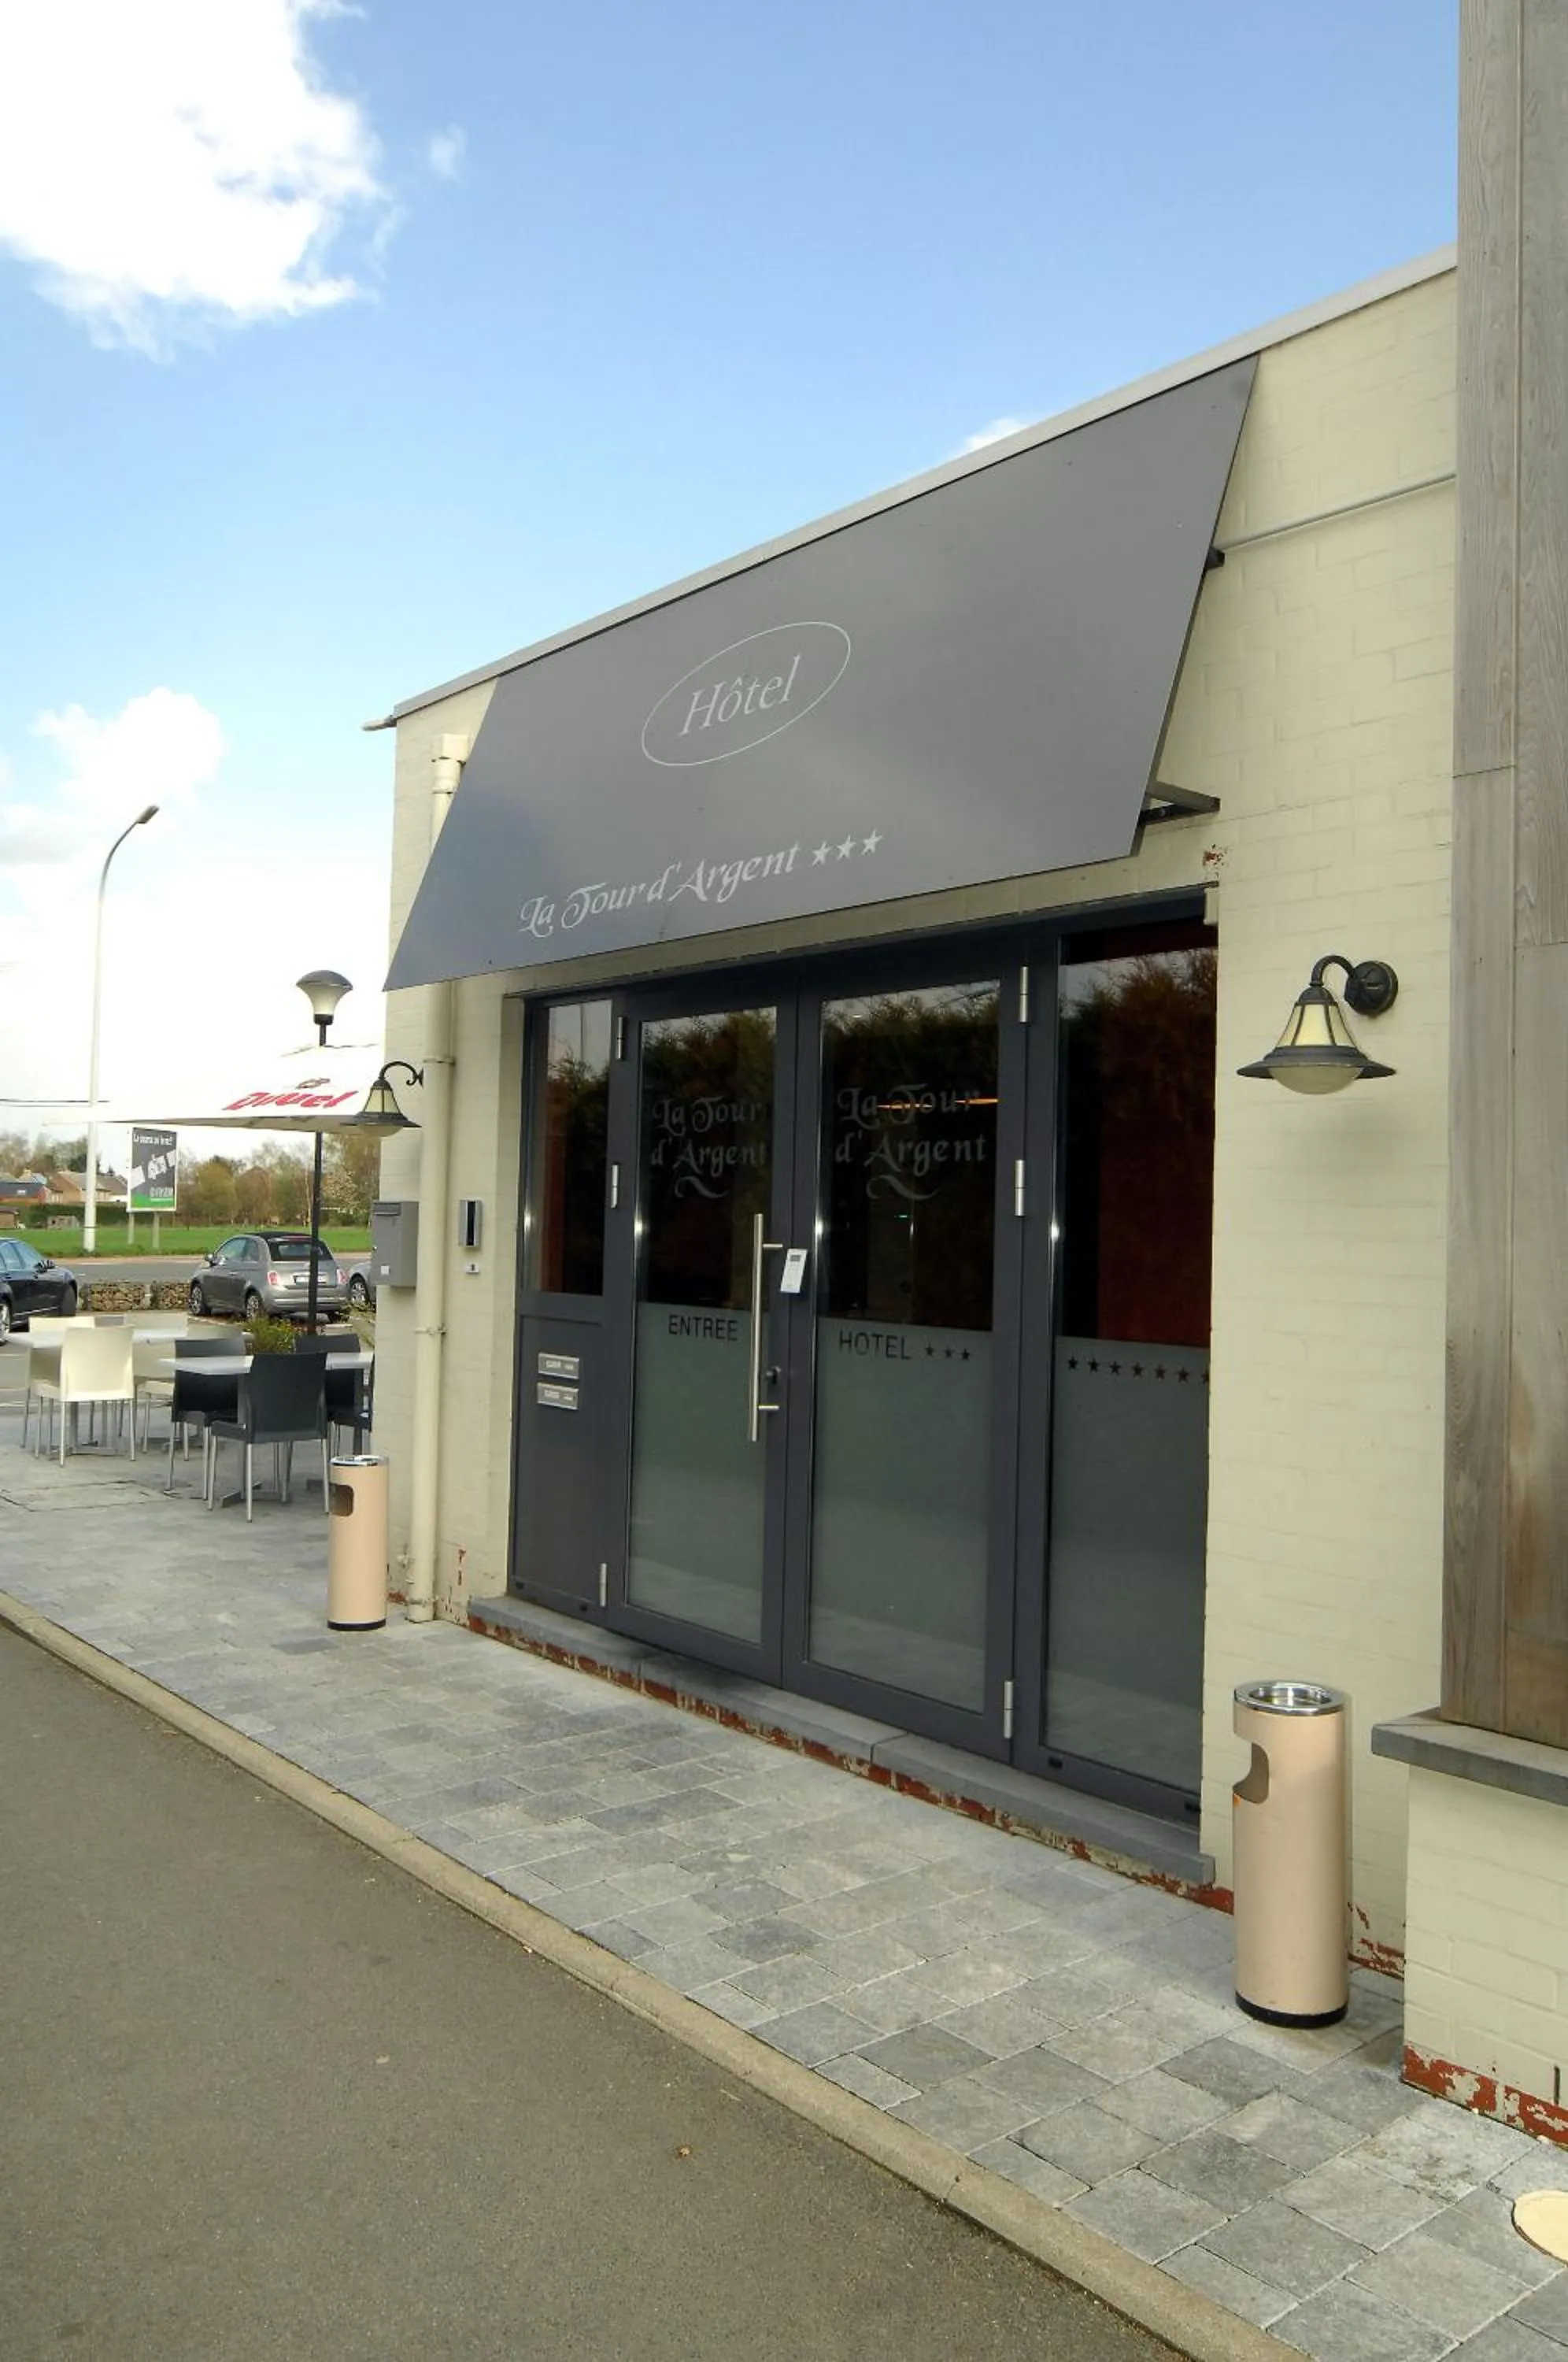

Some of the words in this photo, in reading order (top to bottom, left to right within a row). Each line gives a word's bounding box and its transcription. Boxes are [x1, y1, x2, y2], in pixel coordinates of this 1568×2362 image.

[679, 653, 801, 737] Hôtel
[519, 894, 554, 939] La
[560, 882, 647, 930] Tour
[646, 841, 801, 903] d'Argent
[653, 1098, 686, 1137] La
[691, 1095, 762, 1134] Tour
[837, 1087, 881, 1130] La
[668, 1314, 738, 1341] ENTREE
[838, 1329, 912, 1361] HOTEL
